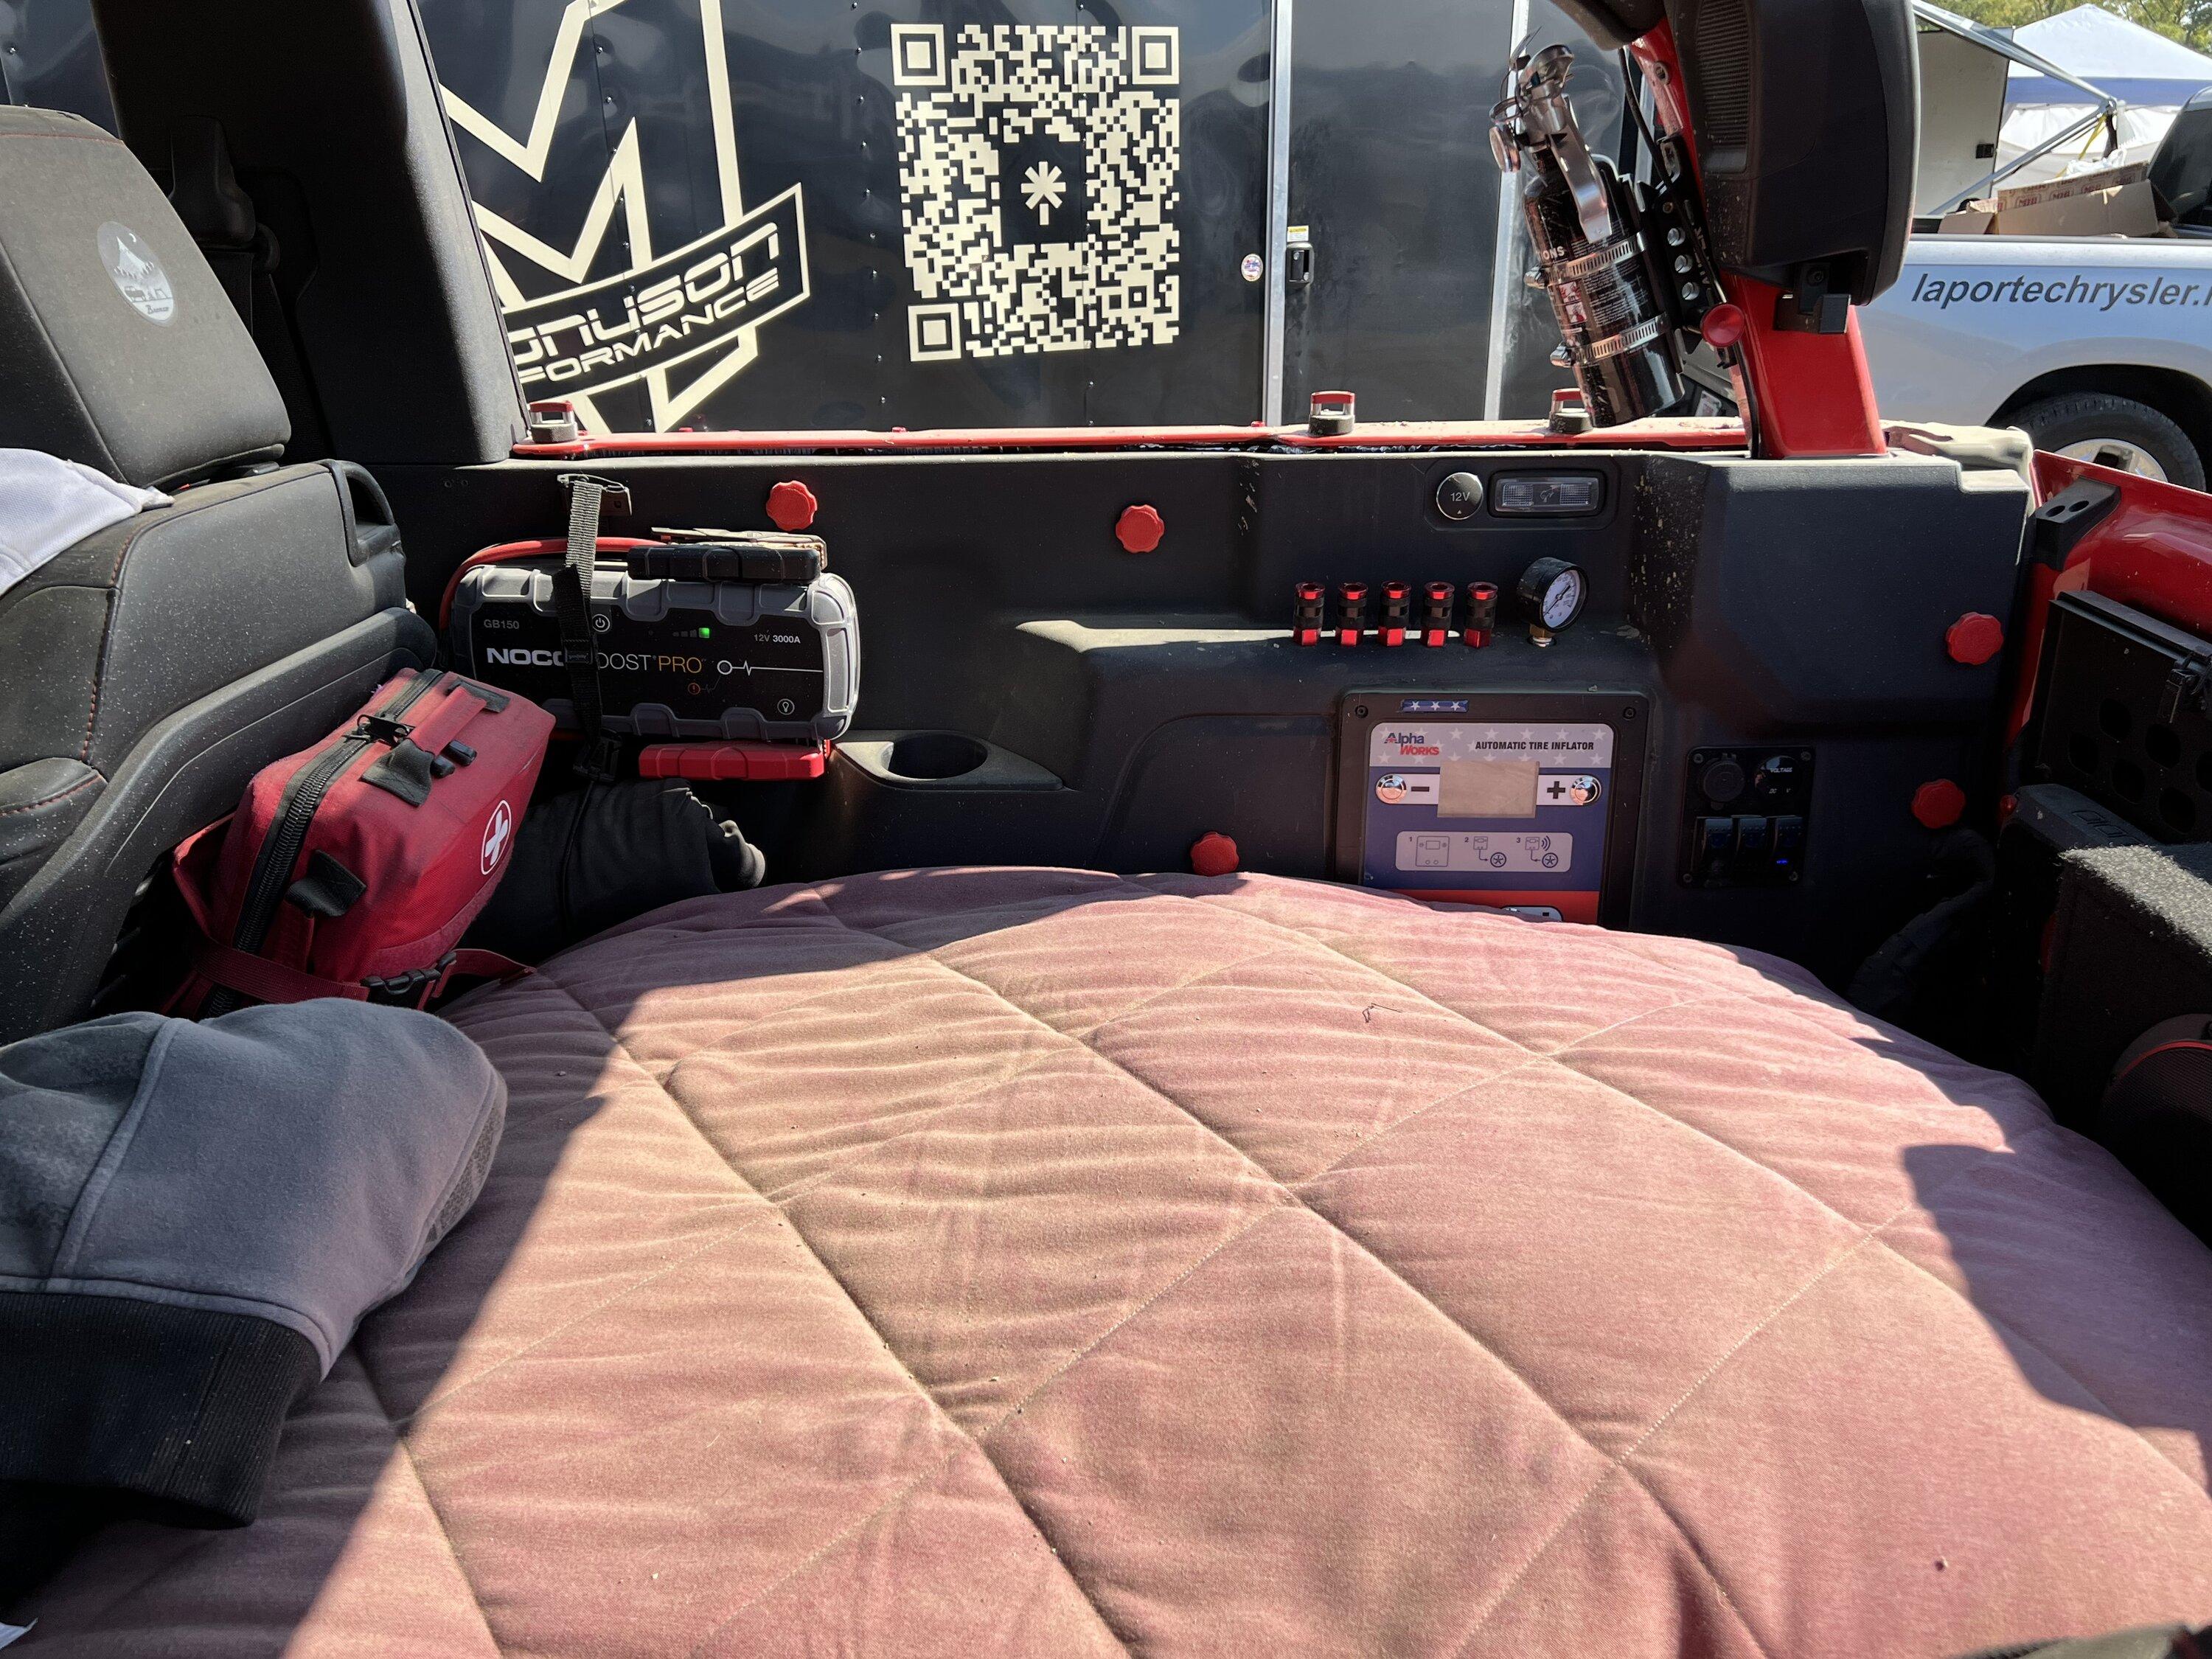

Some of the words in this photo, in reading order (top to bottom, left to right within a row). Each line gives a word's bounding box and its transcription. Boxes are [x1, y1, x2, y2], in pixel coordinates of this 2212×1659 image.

[518, 267, 779, 384] FORMANCE
[1450, 492, 1470, 502] 12V
[484, 619, 520, 629] GB150
[754, 634, 770, 642] 12V
[773, 635, 801, 644] 3000A
[658, 655, 702, 673] PRO
[1384, 732, 1425, 746] Alpha
[1475, 741, 1526, 750] AUTOMATIC
[1529, 742, 1548, 750] TIRE
[1551, 742, 1594, 751] INFLATOR
